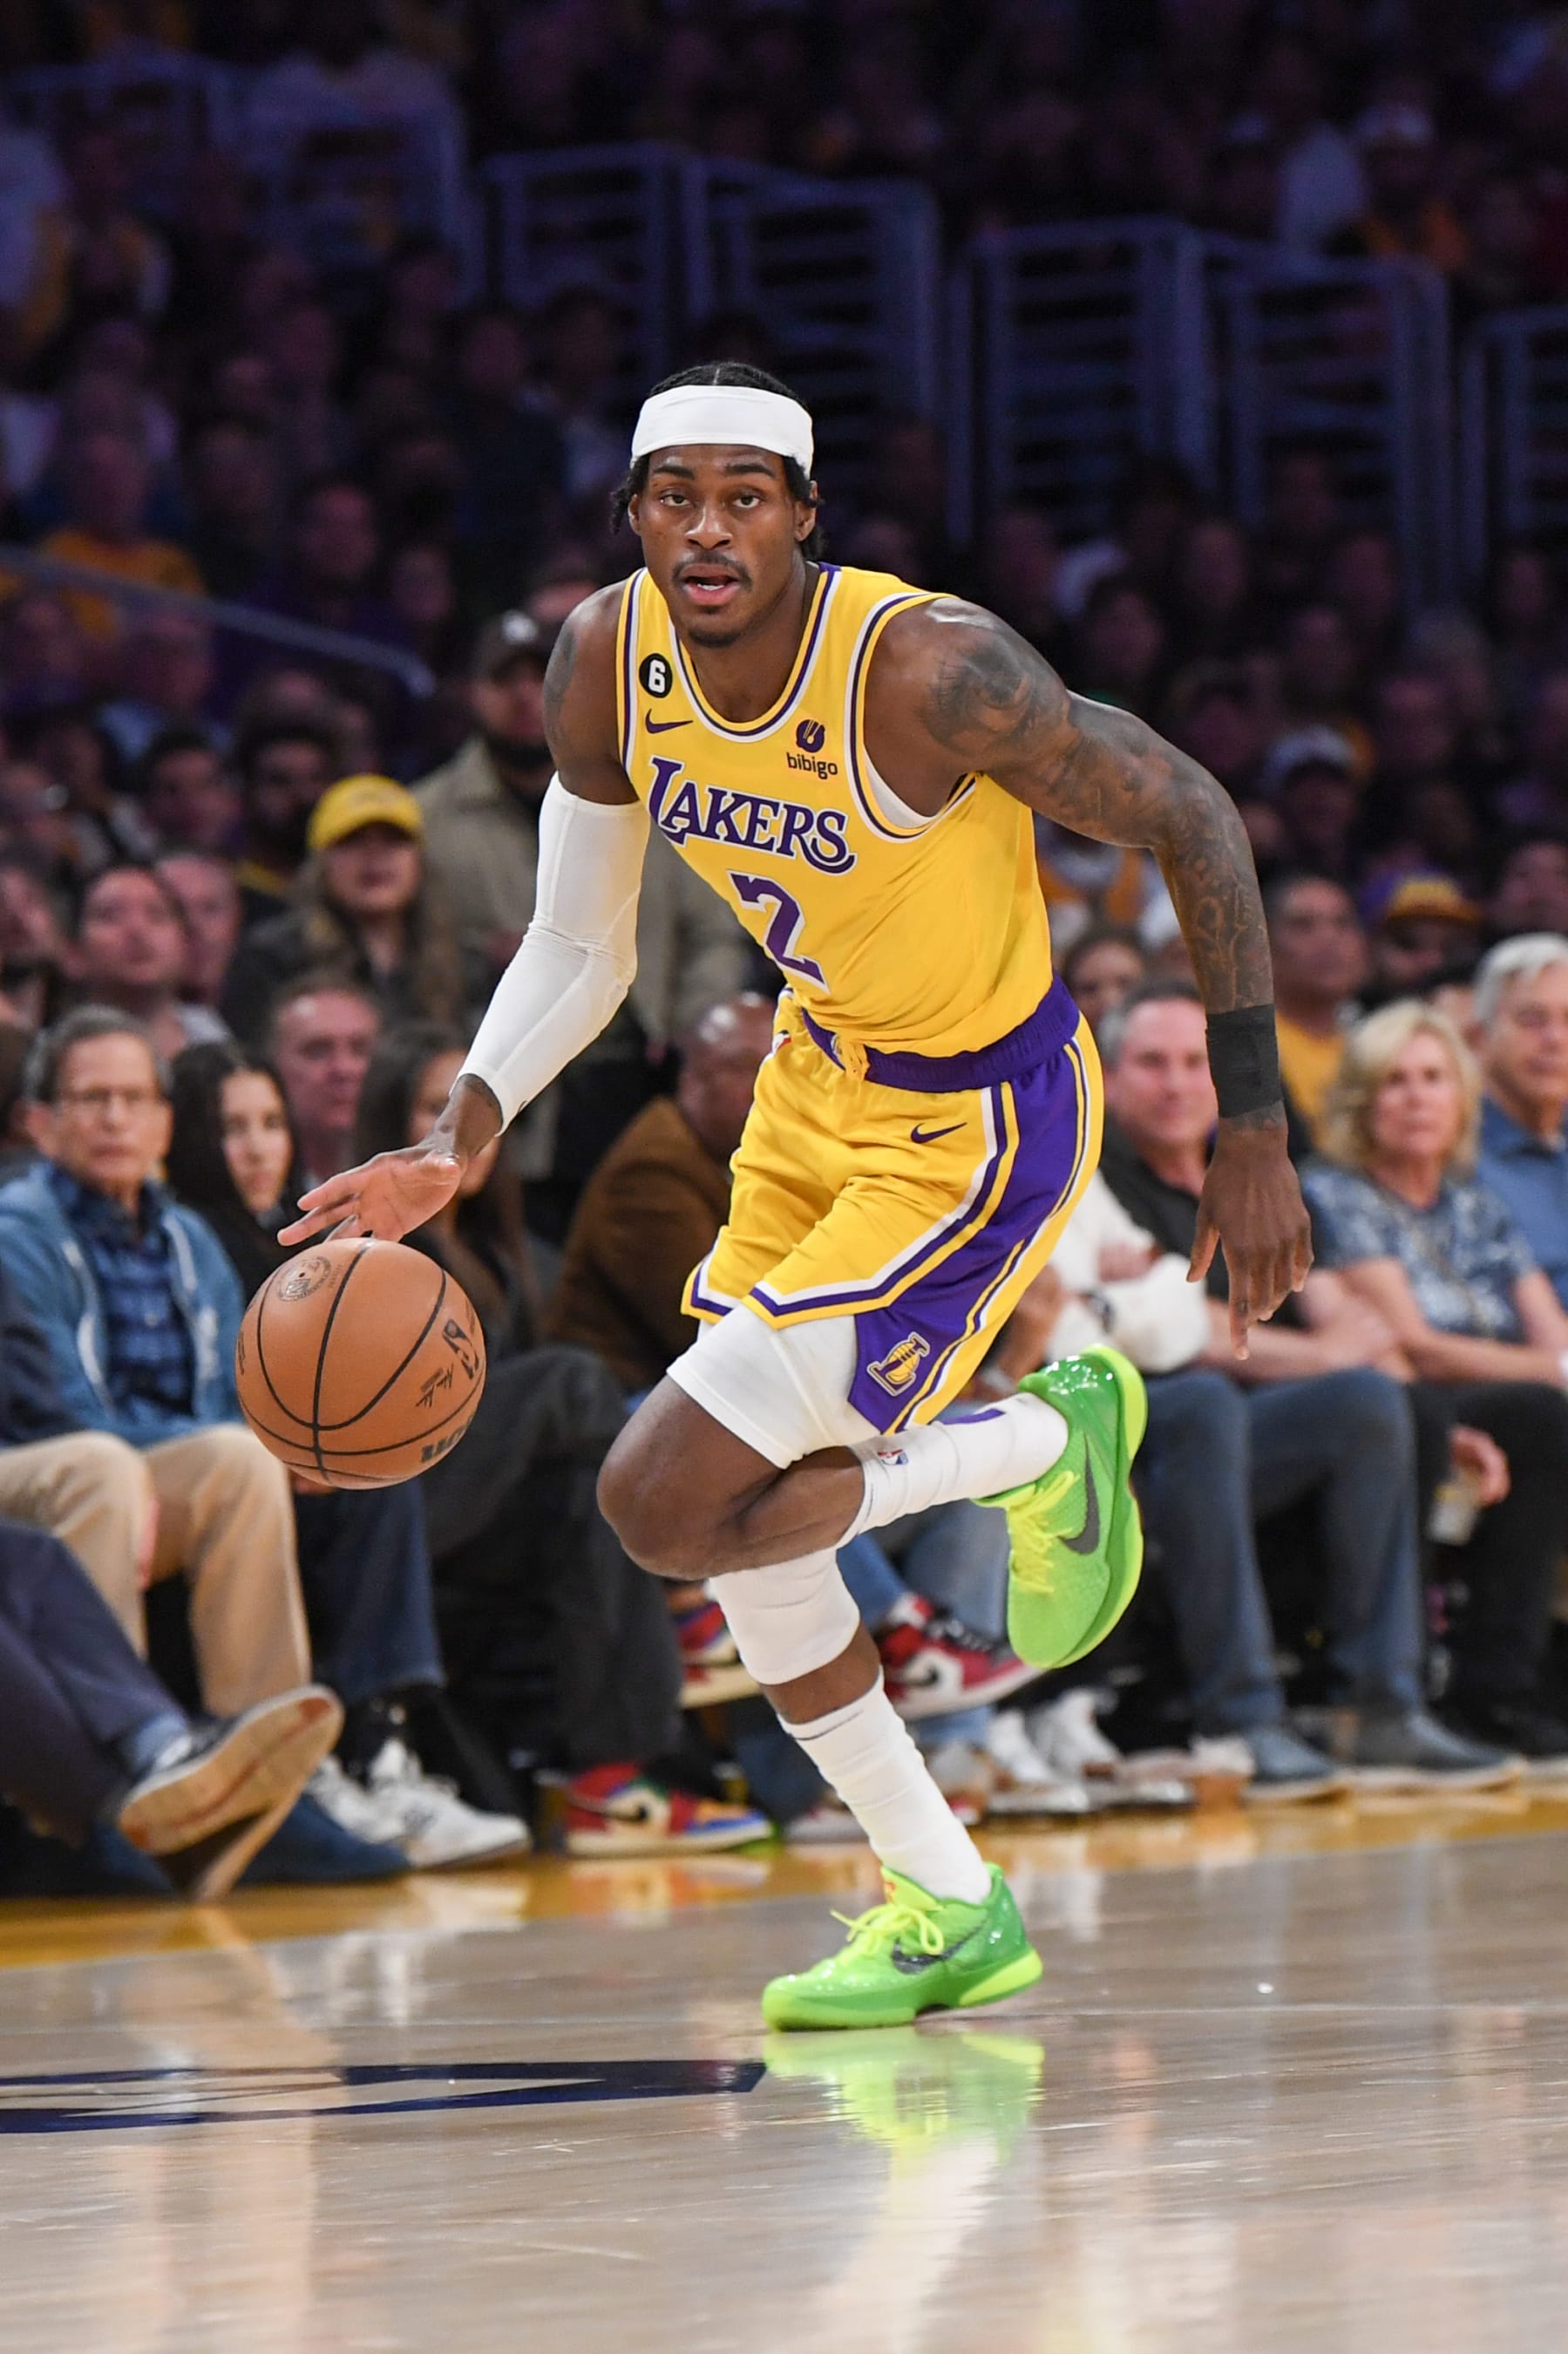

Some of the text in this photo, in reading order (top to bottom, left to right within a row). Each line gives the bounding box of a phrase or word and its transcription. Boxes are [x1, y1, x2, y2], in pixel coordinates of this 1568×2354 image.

[648, 659, 666, 694] 6
[786, 752, 838, 779] bibigo
[648, 755, 857, 875] LAKERS
[727, 870, 830, 993] 2
